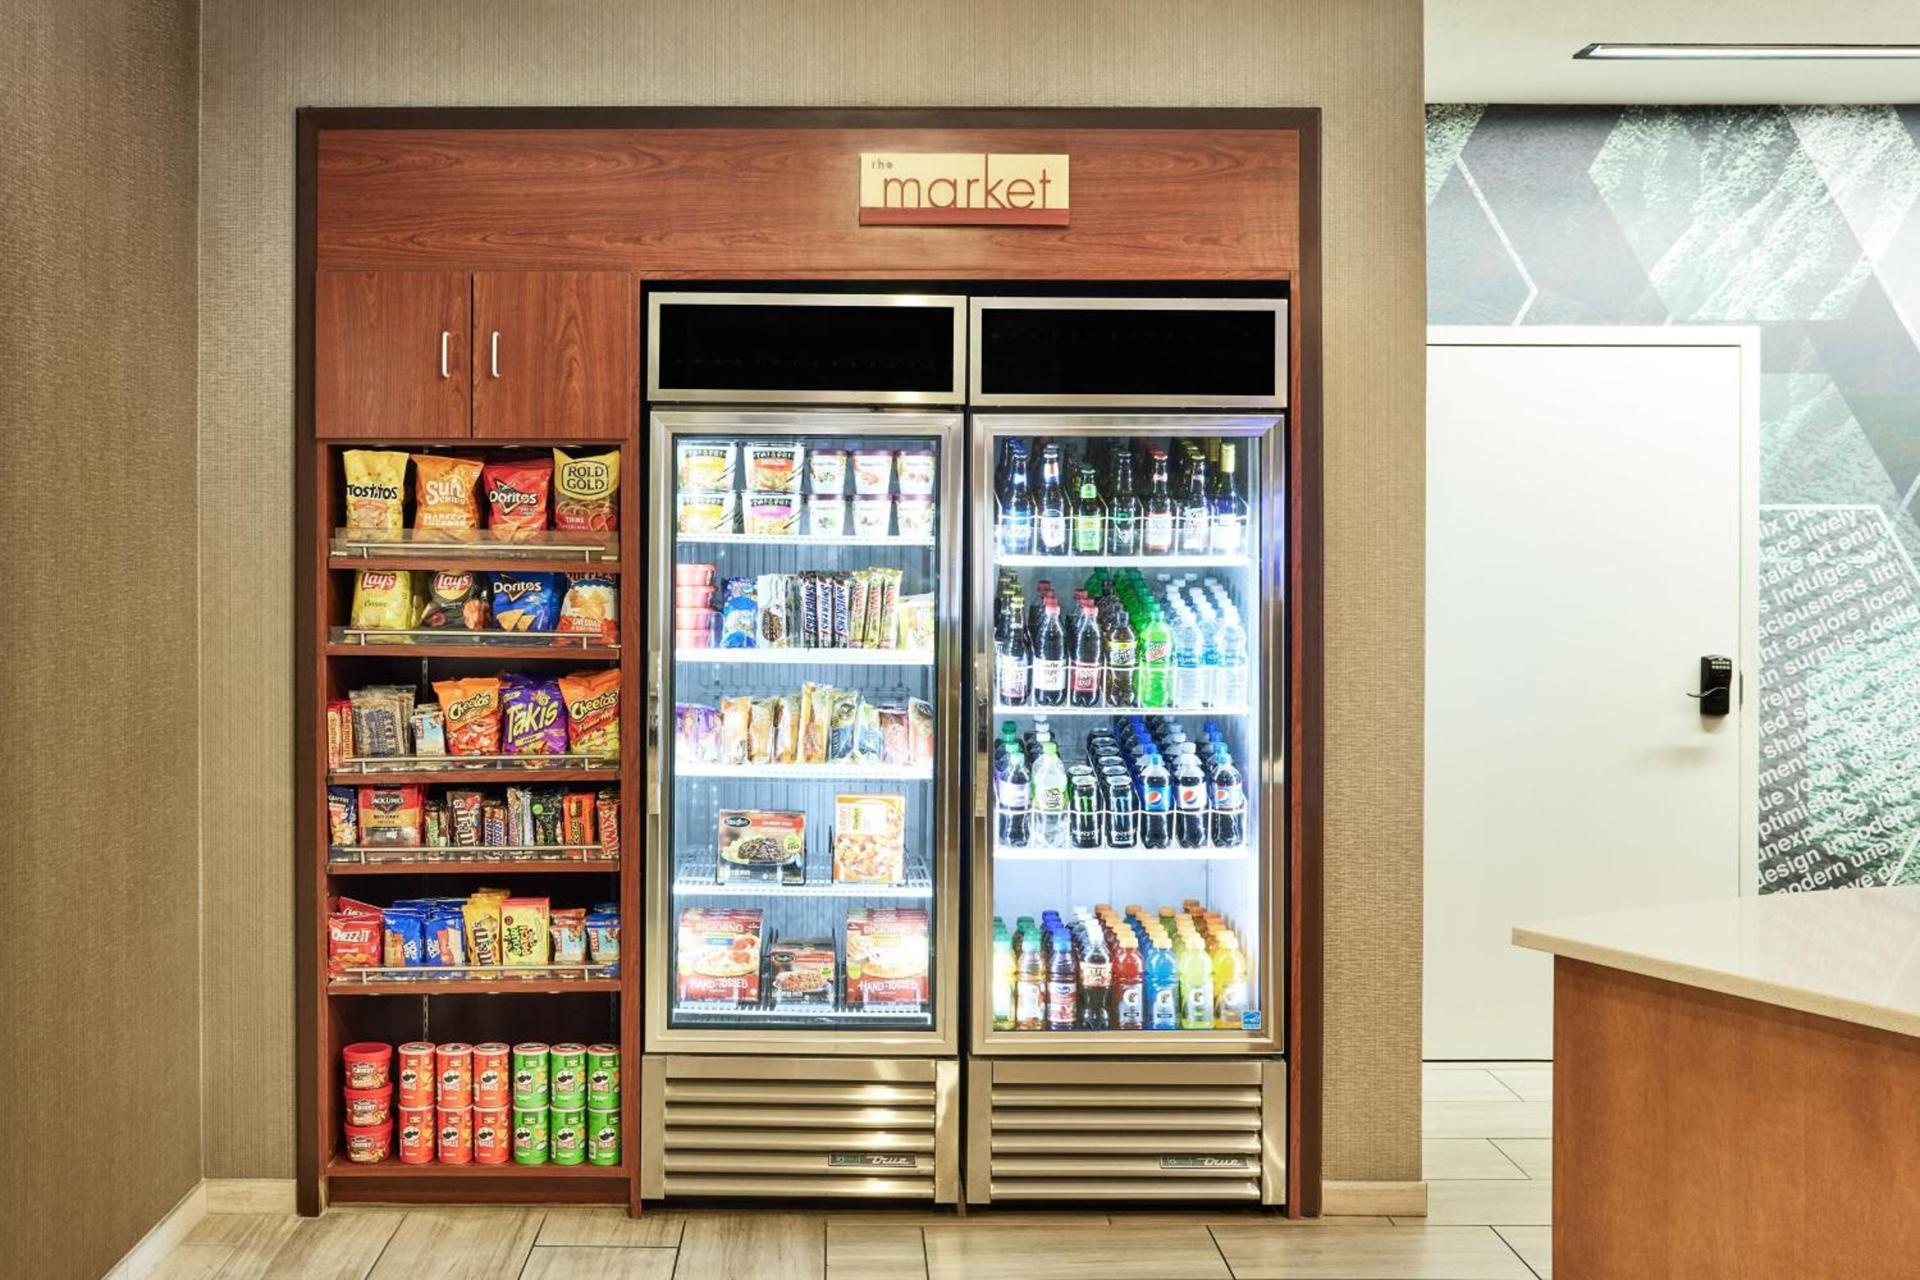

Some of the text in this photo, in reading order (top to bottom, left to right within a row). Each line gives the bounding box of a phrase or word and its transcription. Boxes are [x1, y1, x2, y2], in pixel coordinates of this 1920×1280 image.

[884, 160, 1052, 208] market
[566, 478, 605, 491] GOLD
[567, 466, 604, 479] ROLD
[488, 490, 537, 505] Doritos
[1802, 507, 1859, 541] lively
[1805, 539, 1835, 565] art
[493, 581, 542, 593] Doritos
[1771, 560, 1850, 605] indulge
[1785, 605, 1860, 649] explore
[1860, 577, 1912, 613] local
[1783, 627, 1866, 674] surprise
[570, 691, 618, 720] Cheetos
[506, 701, 559, 744] Takis
